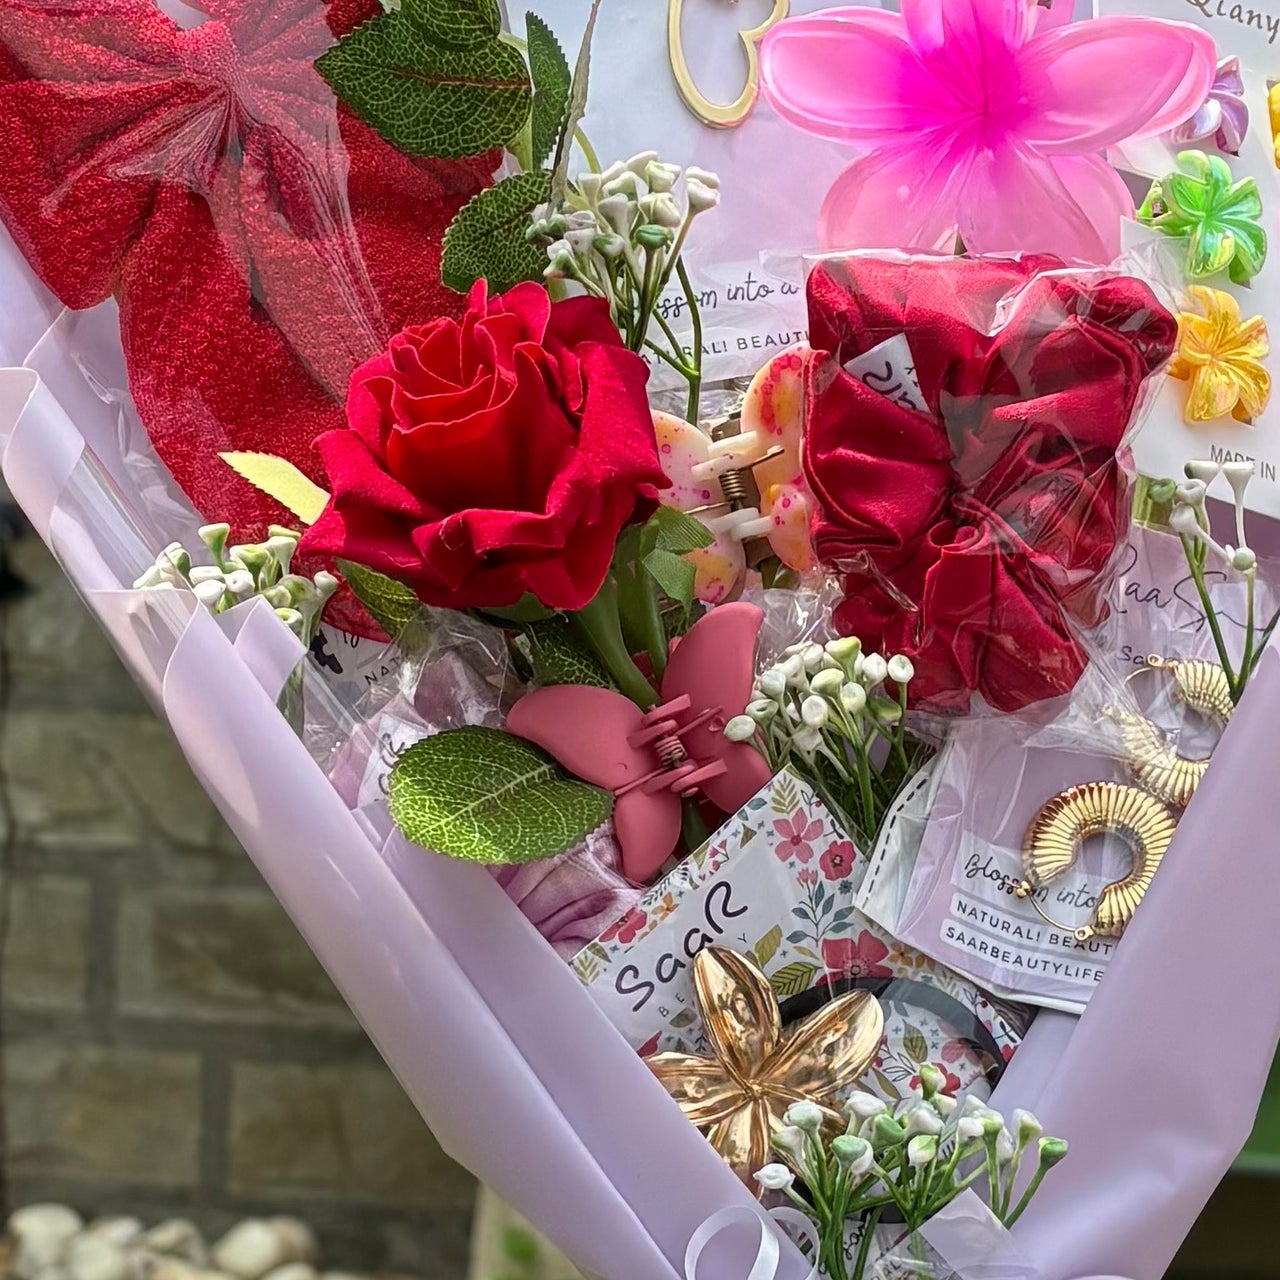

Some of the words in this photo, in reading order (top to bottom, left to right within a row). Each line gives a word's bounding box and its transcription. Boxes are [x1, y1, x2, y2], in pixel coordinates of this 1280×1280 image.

[727, 271, 774, 302] into
[1260, 461, 1276, 482] IN
[1057, 883, 1098, 908] into
[615, 881, 748, 1012] SaaR
[957, 900, 1041, 942] NATURAL!
[1049, 933, 1113, 956] BEAUT
[946, 926, 1104, 982] SAARBEAUTYLIFE
